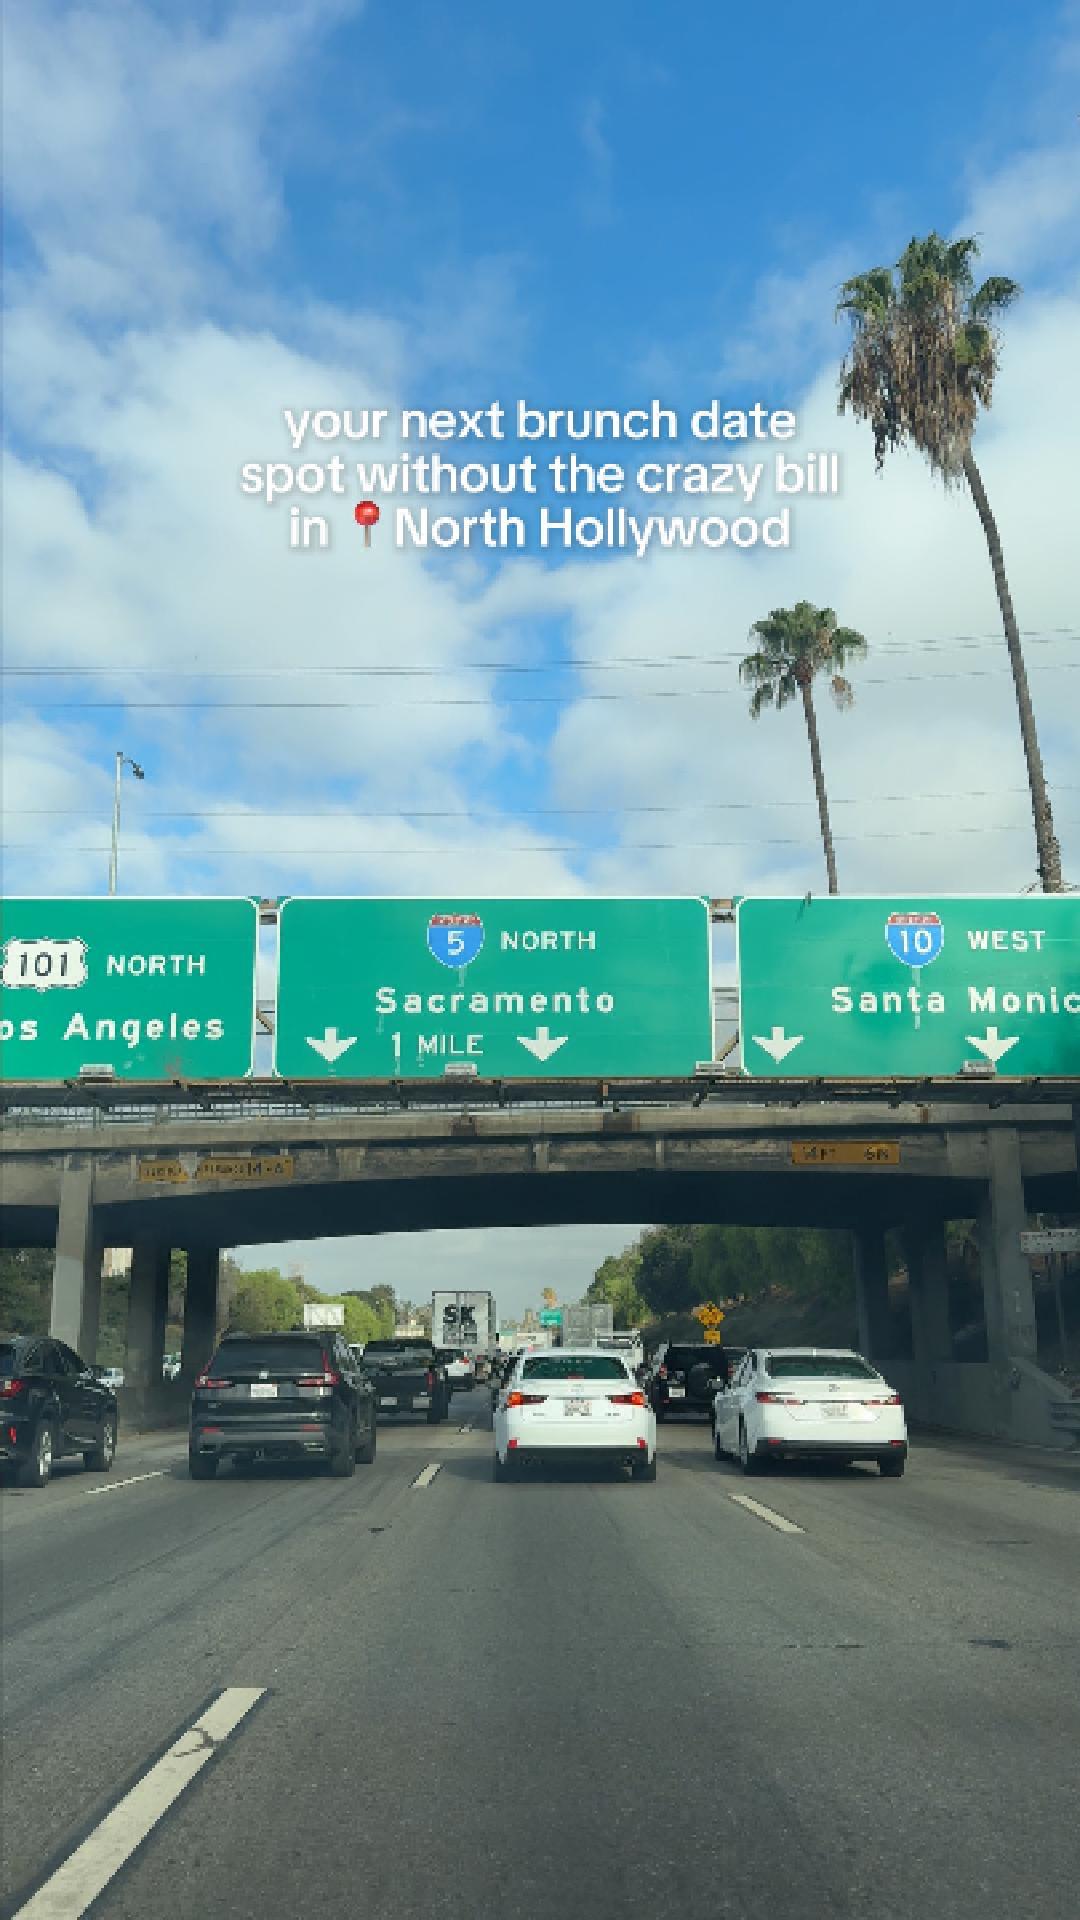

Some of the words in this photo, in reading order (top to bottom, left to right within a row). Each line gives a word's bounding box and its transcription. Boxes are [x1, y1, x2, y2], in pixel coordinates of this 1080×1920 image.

[447, 930, 465, 956] 5
[500, 930, 596, 950] NORTH
[900, 929, 932, 954] 10
[967, 930, 1046, 951] WEST
[20, 952, 68, 977] 101
[106, 954, 206, 976] NORTH
[375, 986, 614, 1014] Sacramento
[831, 986, 945, 1014] Santa
[63, 1012, 224, 1048] Angeles
[391, 1032, 401, 1057] 1
[418, 1034, 484, 1054] MILE
